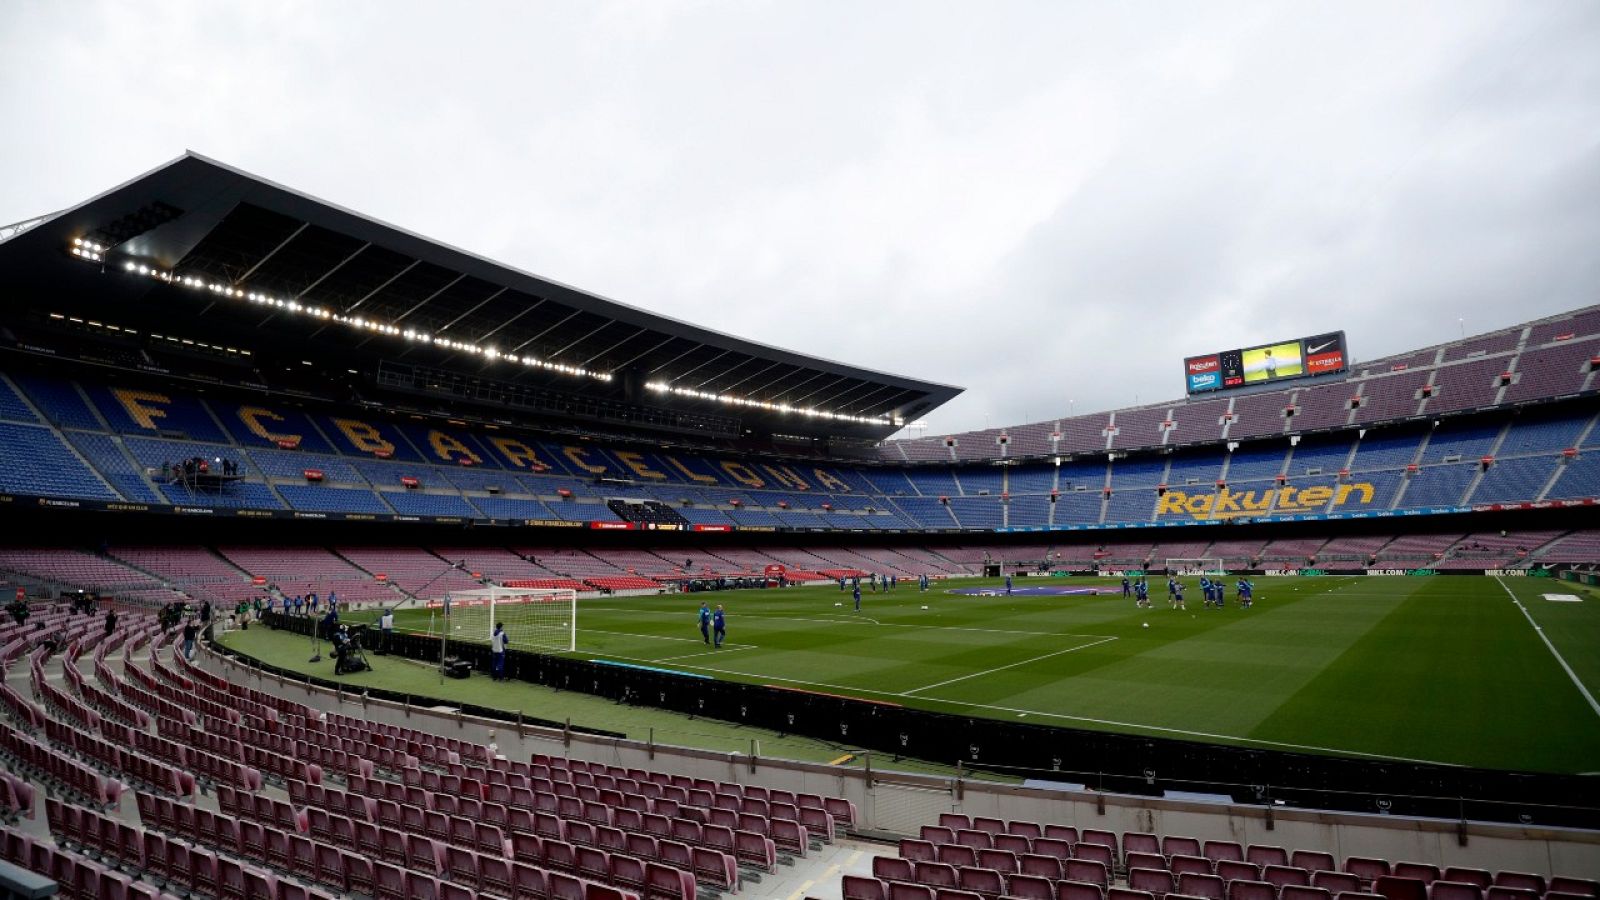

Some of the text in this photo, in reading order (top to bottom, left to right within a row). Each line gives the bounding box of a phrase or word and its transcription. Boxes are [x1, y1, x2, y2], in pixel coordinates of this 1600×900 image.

[1193, 375, 1216, 383] beko
[329, 416, 851, 493] BARCELONA
[1157, 482, 1375, 516] Rakuten
